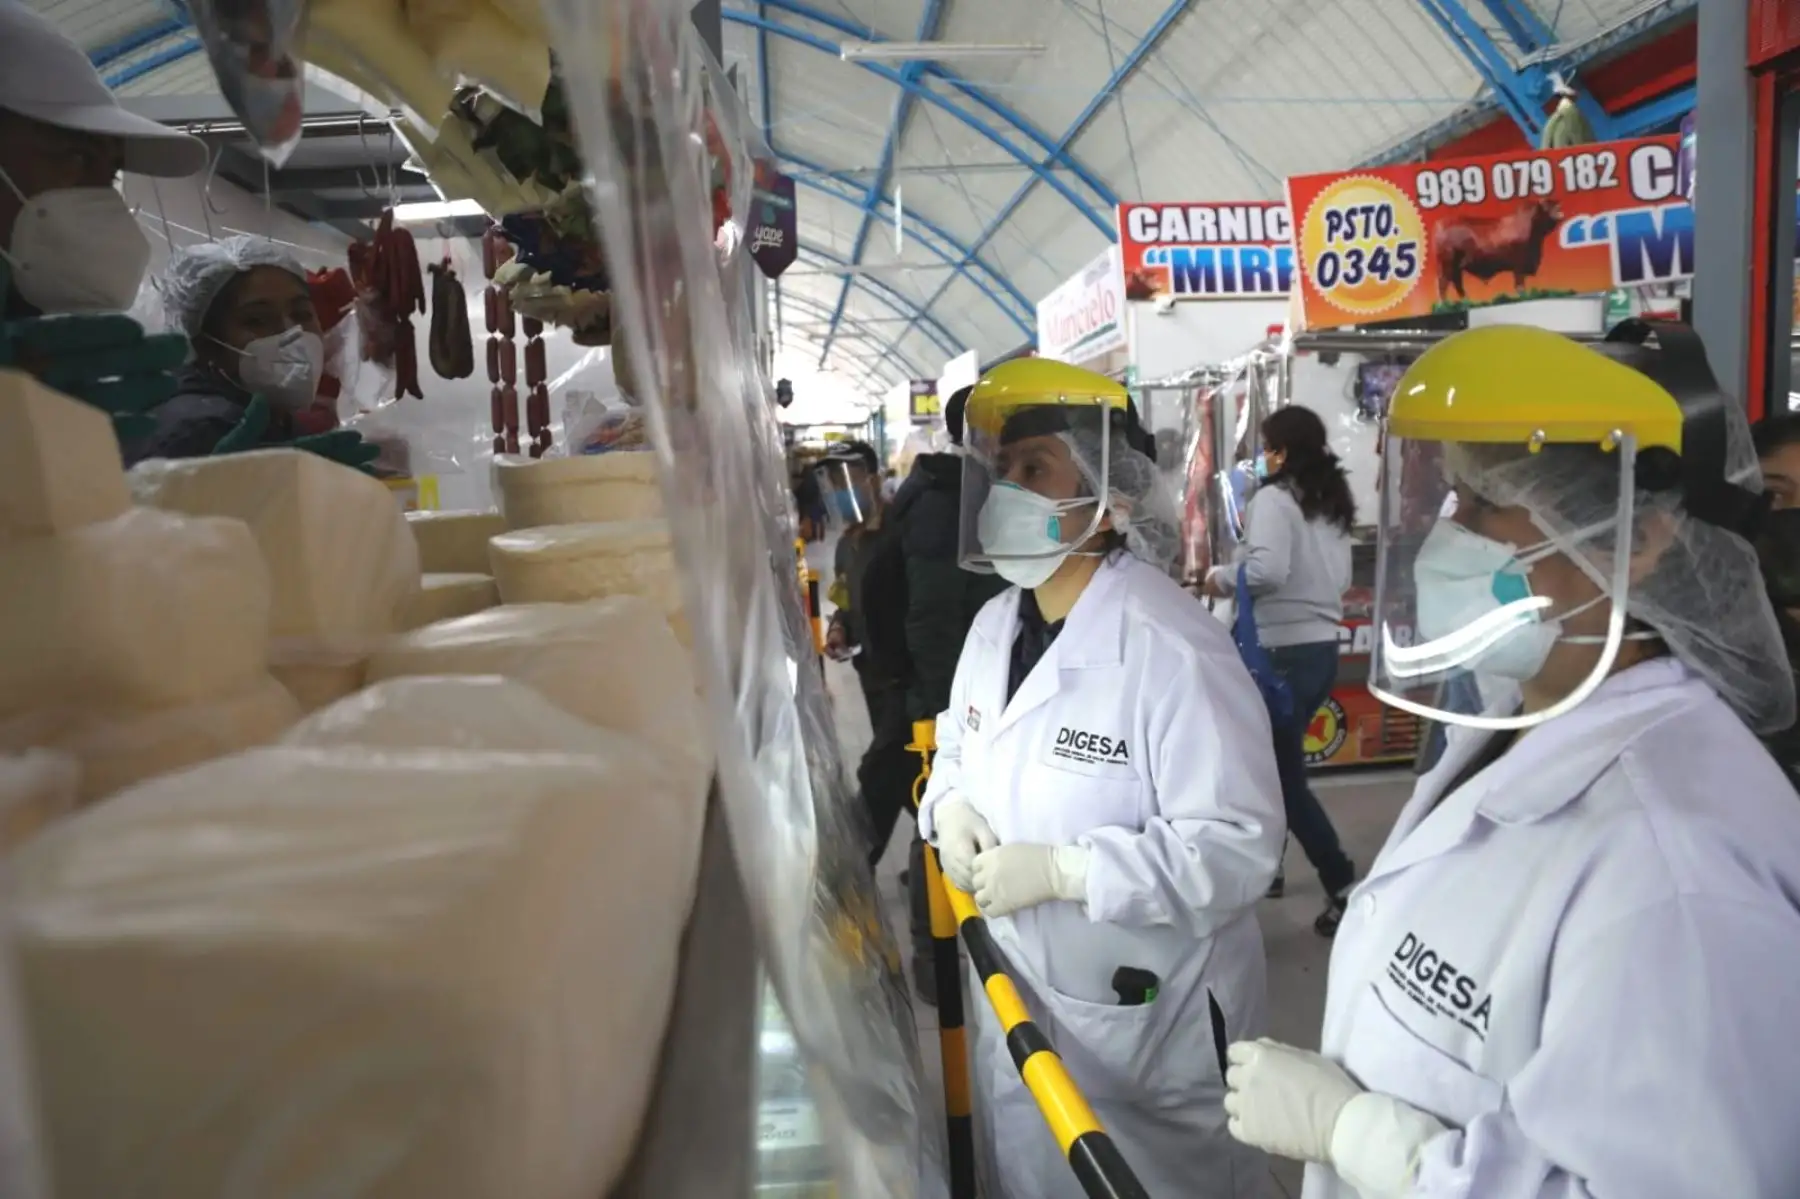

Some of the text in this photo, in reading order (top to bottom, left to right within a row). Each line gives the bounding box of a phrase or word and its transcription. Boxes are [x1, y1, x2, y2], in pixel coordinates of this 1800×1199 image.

[1416, 151, 1618, 209] 989 079 182
[1630, 144, 1682, 201] C
[752, 225, 783, 253] yape
[1128, 206, 1290, 243] CARNIC
[1326, 204, 1399, 243] PSTO.
[1316, 241, 1417, 288] 0345
[1056, 727, 1128, 758] DIGESA
[1394, 932, 1491, 1031] DIGESA
